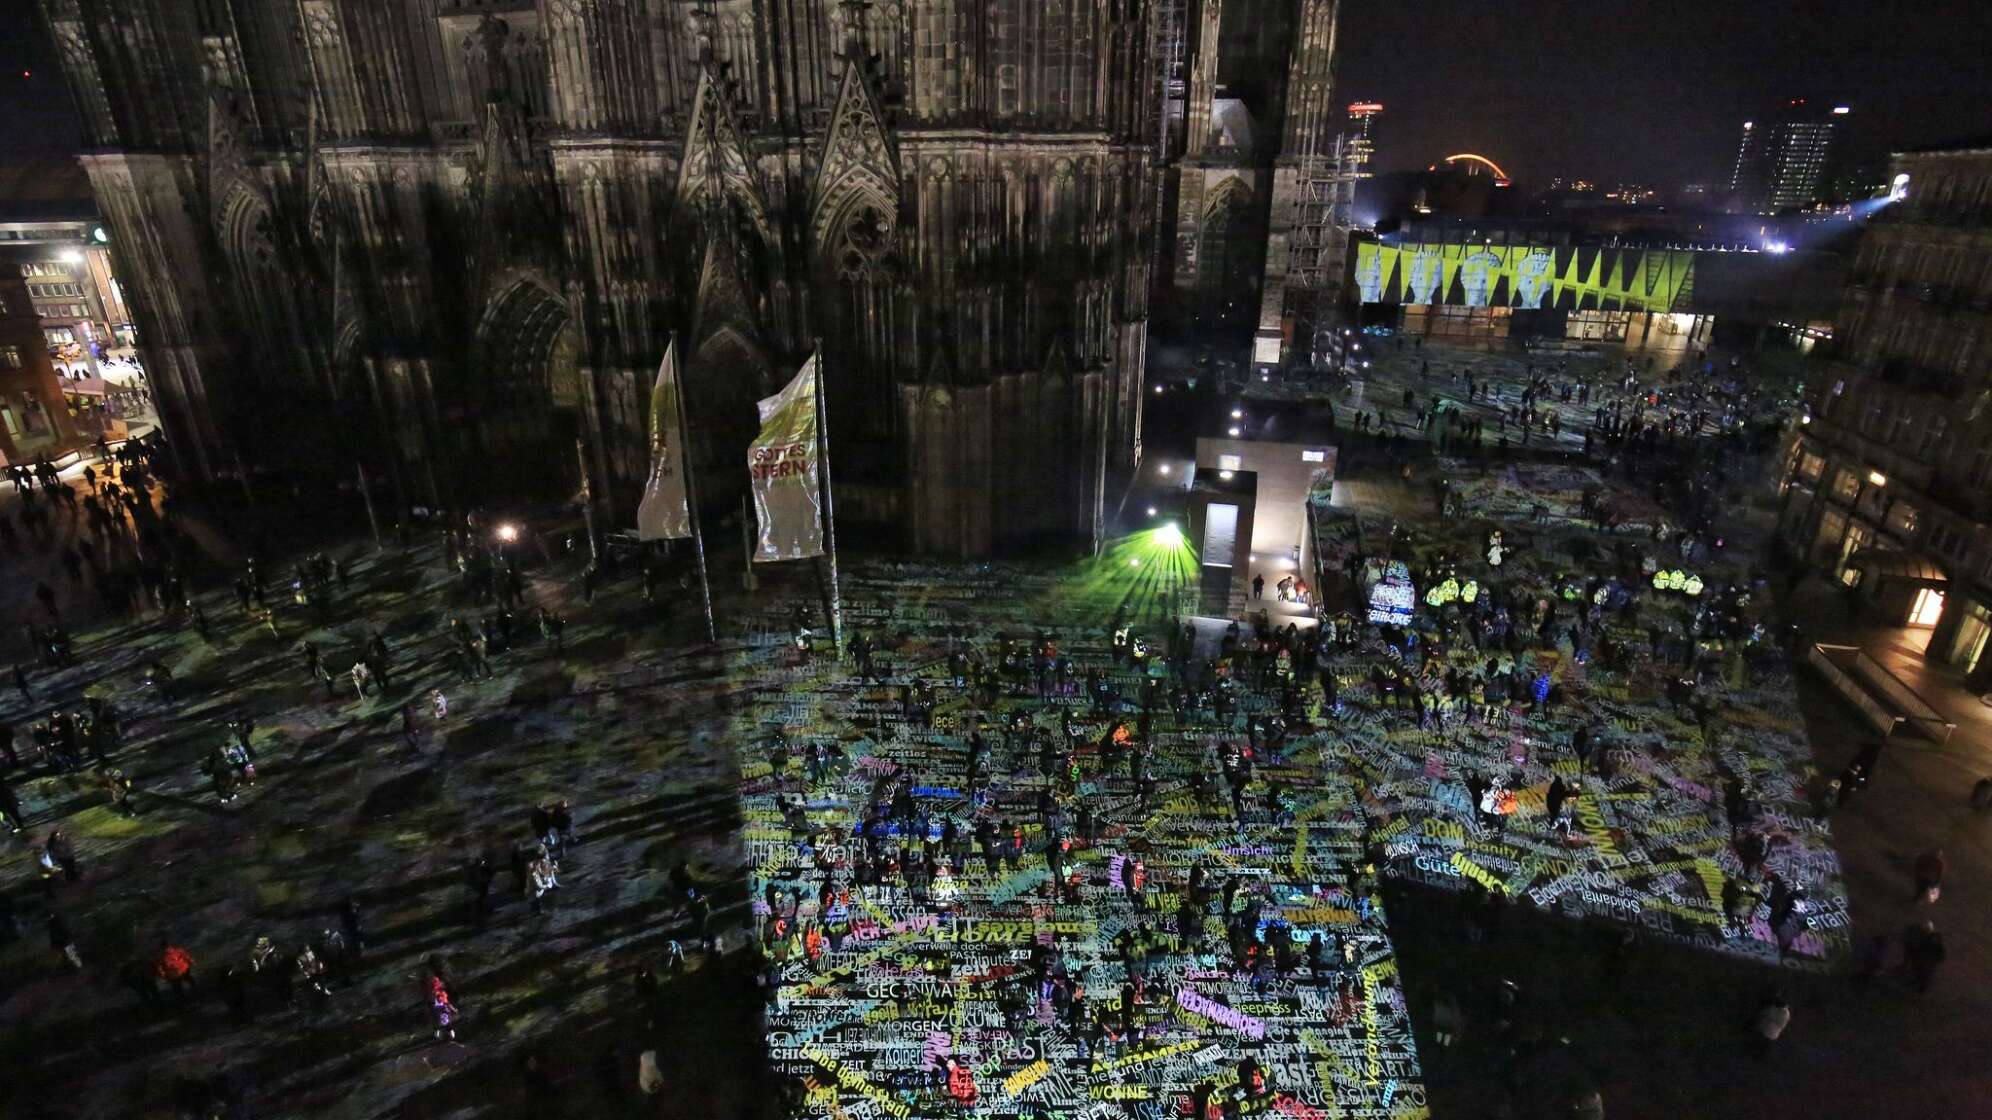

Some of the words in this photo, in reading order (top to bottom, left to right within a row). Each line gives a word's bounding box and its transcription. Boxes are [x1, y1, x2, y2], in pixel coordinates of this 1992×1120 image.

[755, 443, 806, 461] GOTTES
[752, 460, 806, 480] STERN
[1424, 817, 1464, 840] DOM
[1415, 855, 1461, 877] Güte
[1582, 890, 1641, 914] Solidarität
[951, 962, 990, 978] zeit
[866, 981, 973, 999] GENWART
[877, 1020, 942, 1033] MORGEN
[788, 1063, 815, 1075] jetzt
[841, 1060, 866, 1070] ZEIT
[1087, 1084, 1149, 1100] WONNE
